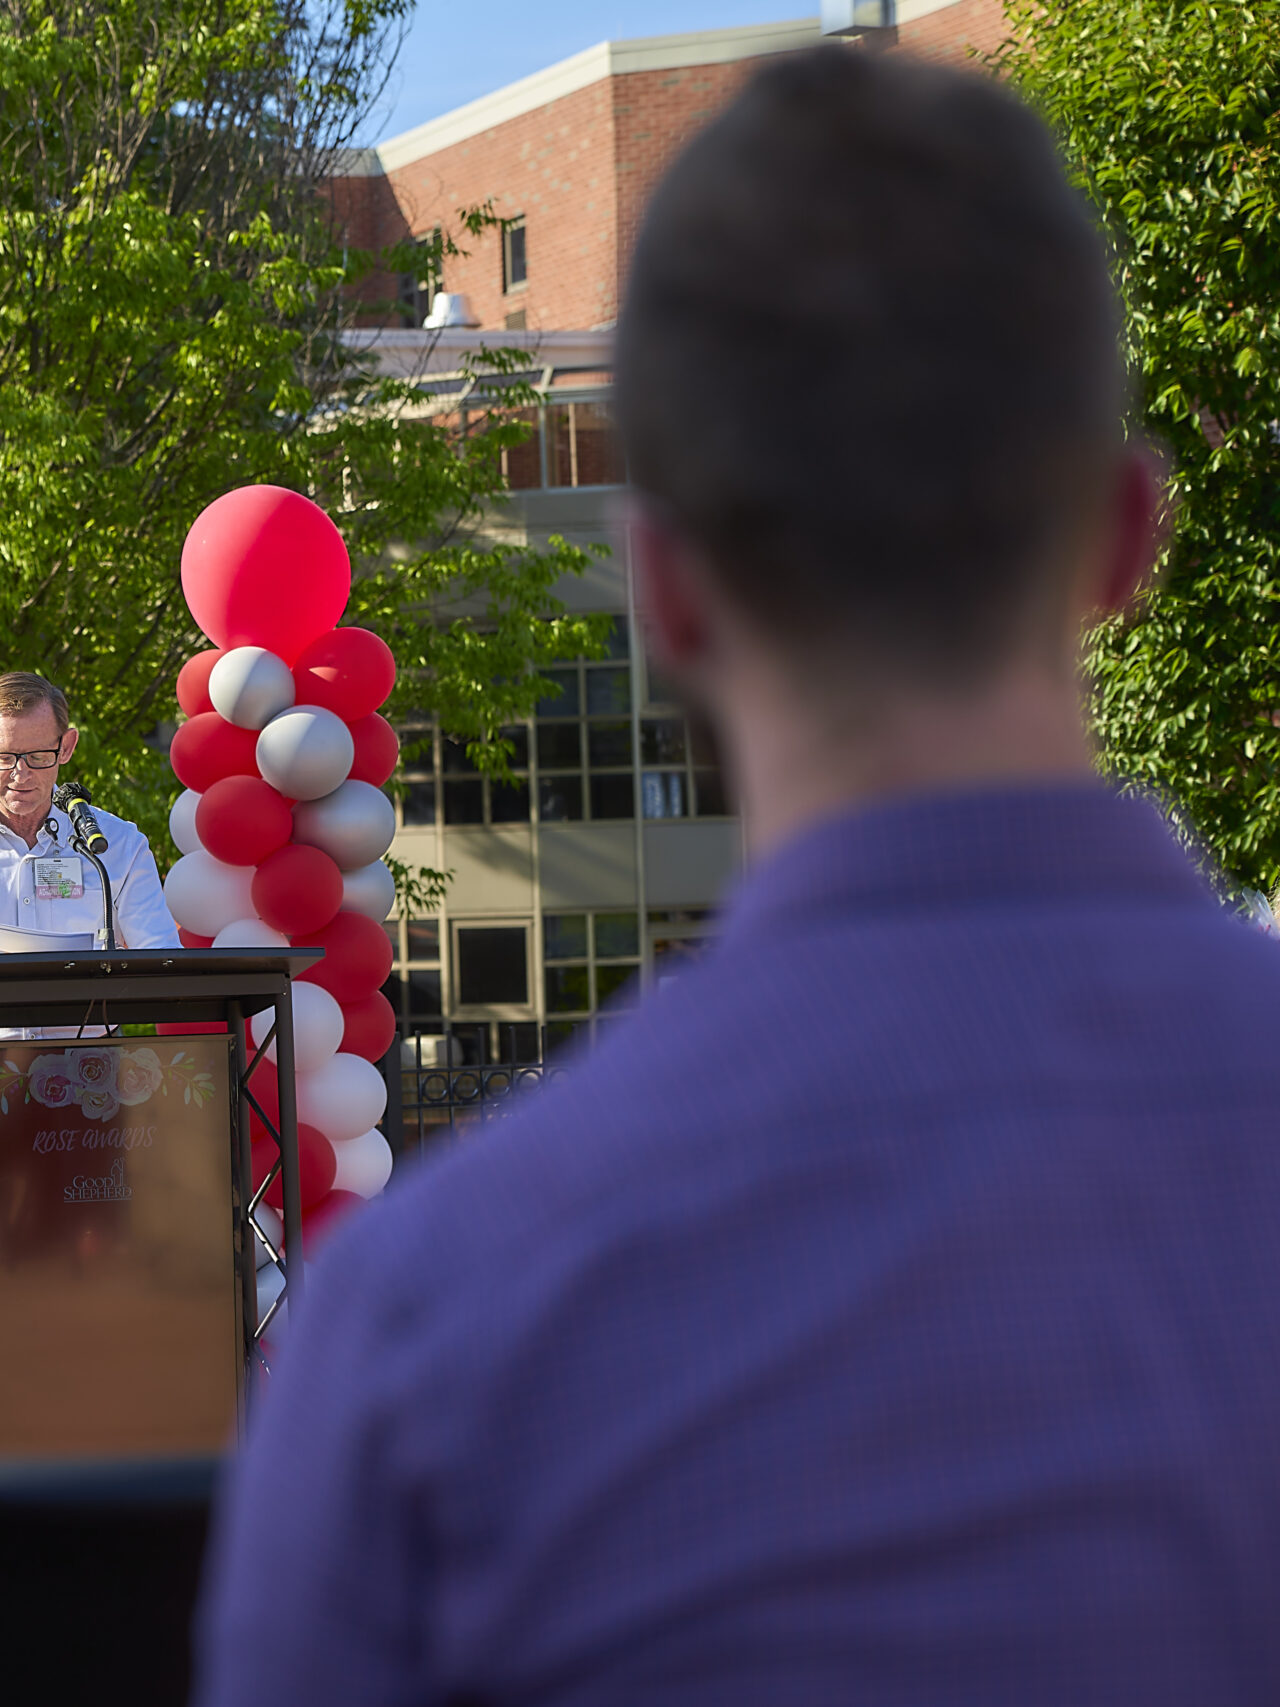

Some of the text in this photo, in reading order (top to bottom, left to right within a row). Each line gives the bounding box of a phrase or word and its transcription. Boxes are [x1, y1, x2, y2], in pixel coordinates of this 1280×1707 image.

[32, 1128, 80, 1154] ROSE
[72, 1175, 115, 1189] GOOD
[63, 1186, 133, 1200] SHEPHERD
